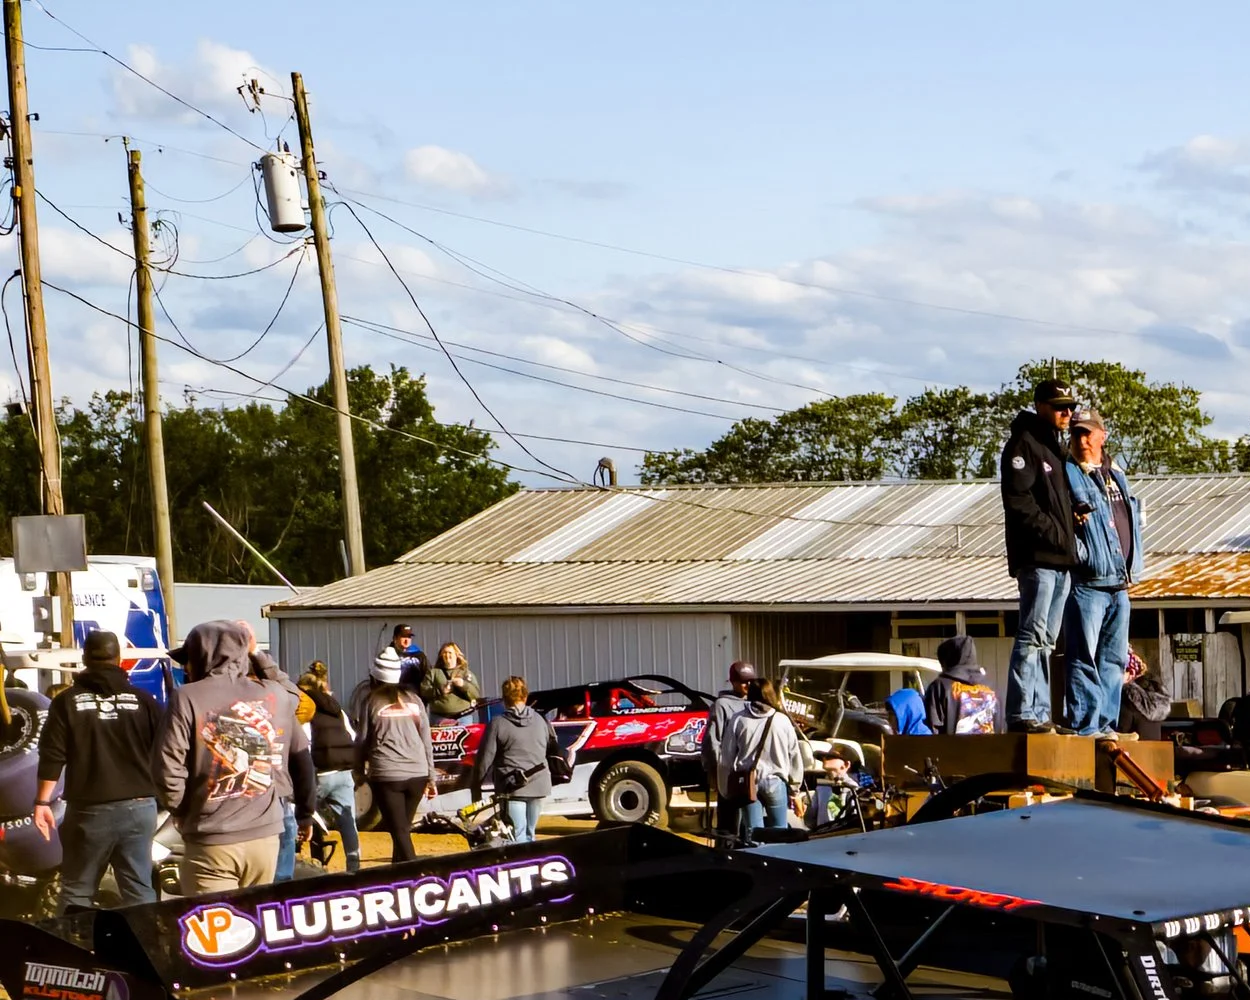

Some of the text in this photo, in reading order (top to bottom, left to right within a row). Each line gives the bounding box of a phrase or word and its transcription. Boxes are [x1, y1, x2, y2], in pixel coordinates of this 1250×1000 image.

[73, 593, 106, 607] ULANCE
[186, 861, 570, 954] VP LUBRICANTS
